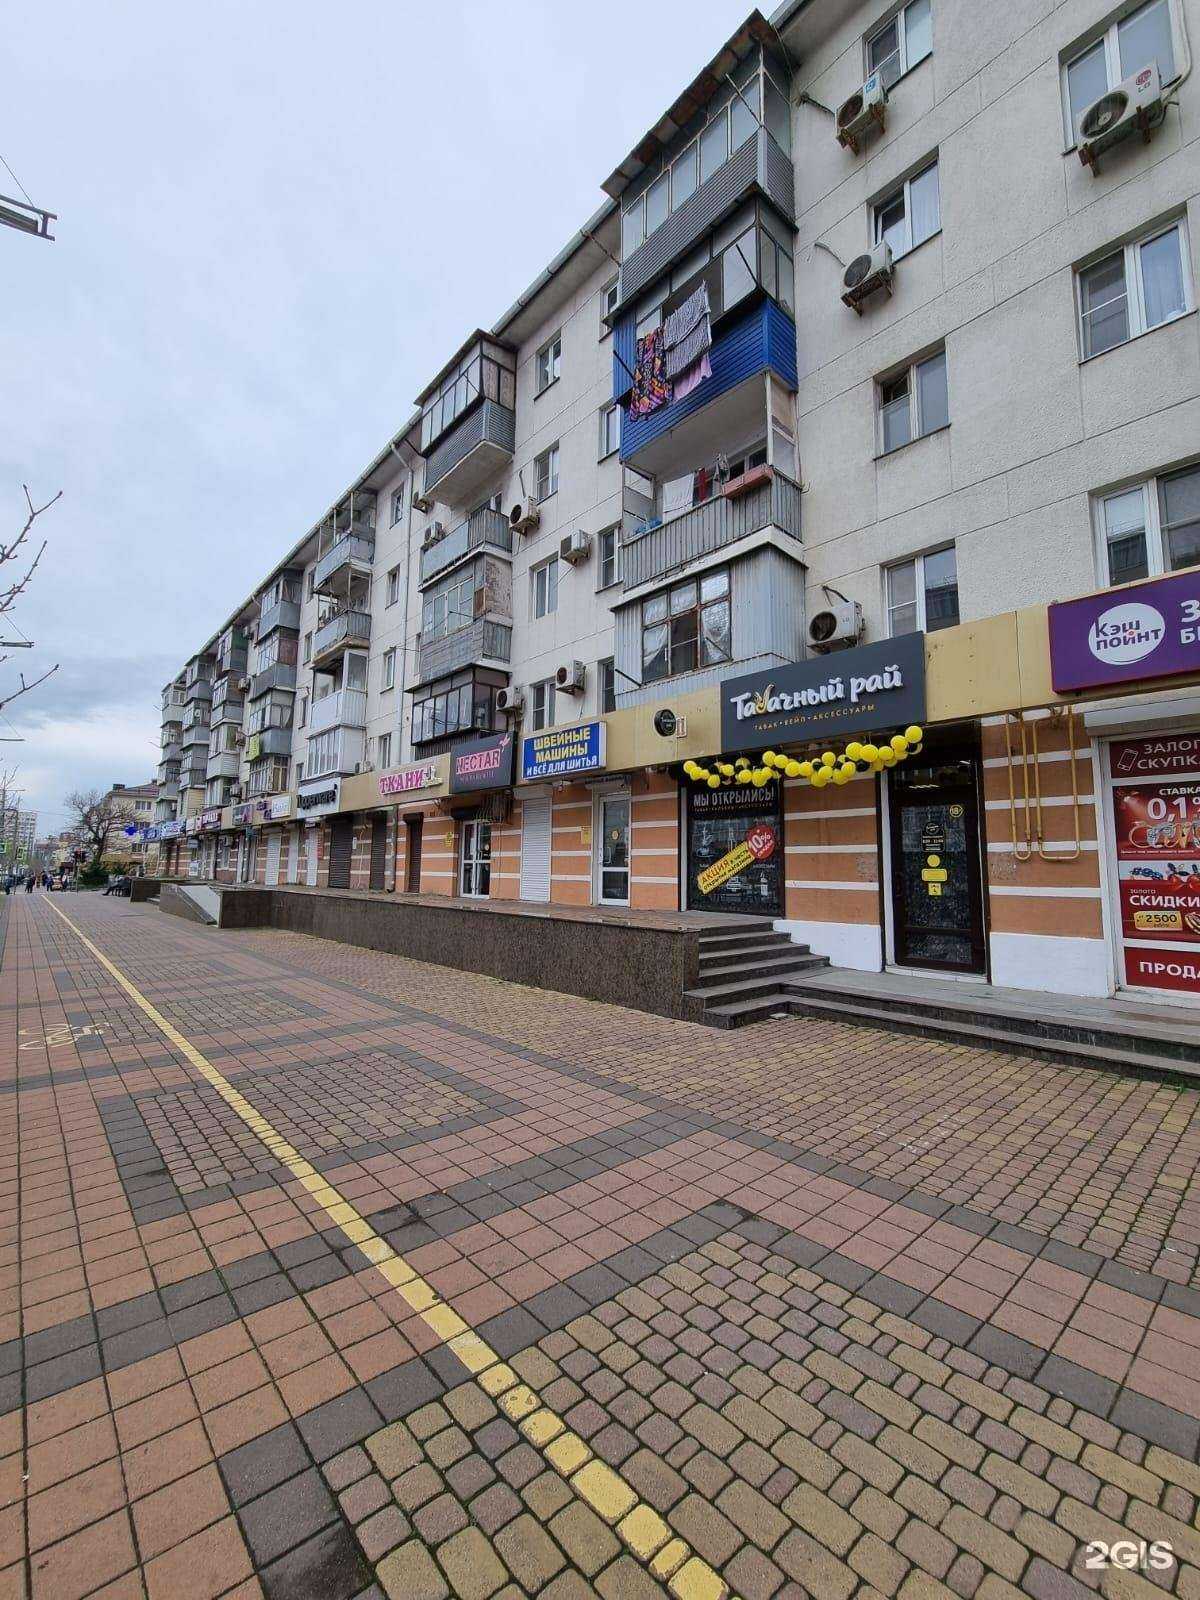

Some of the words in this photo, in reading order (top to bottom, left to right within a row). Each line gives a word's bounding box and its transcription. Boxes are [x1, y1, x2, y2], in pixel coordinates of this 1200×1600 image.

[1180, 626, 1200, 644] Б
[850, 665, 903, 703] рай
[813, 704, 875, 721] АКСЕССУАРЫ
[533, 727, 591, 750] ШВЕЙНЫЕ
[456, 749, 500, 774] NECTAR
[535, 743, 588, 763] МАШИНЫ
[1137, 755, 1200, 769] СКУПК
[527, 767, 532, 776] И
[548, 763, 565, 773] ДЛЯ
[566, 755, 597, 770] ШИТЬЯ
[379, 769, 424, 794] ТКАНИ
[693, 794, 709, 807] МЫ
[712, 786, 774, 806] ОТКРЫЛИСЬ!
[748, 832, 771, 853] 10%
[701, 861, 729, 884] АКЦИЯ
[1130, 895, 1200, 908] СКИДКИ
[1139, 961, 1200, 979] ПРОД
